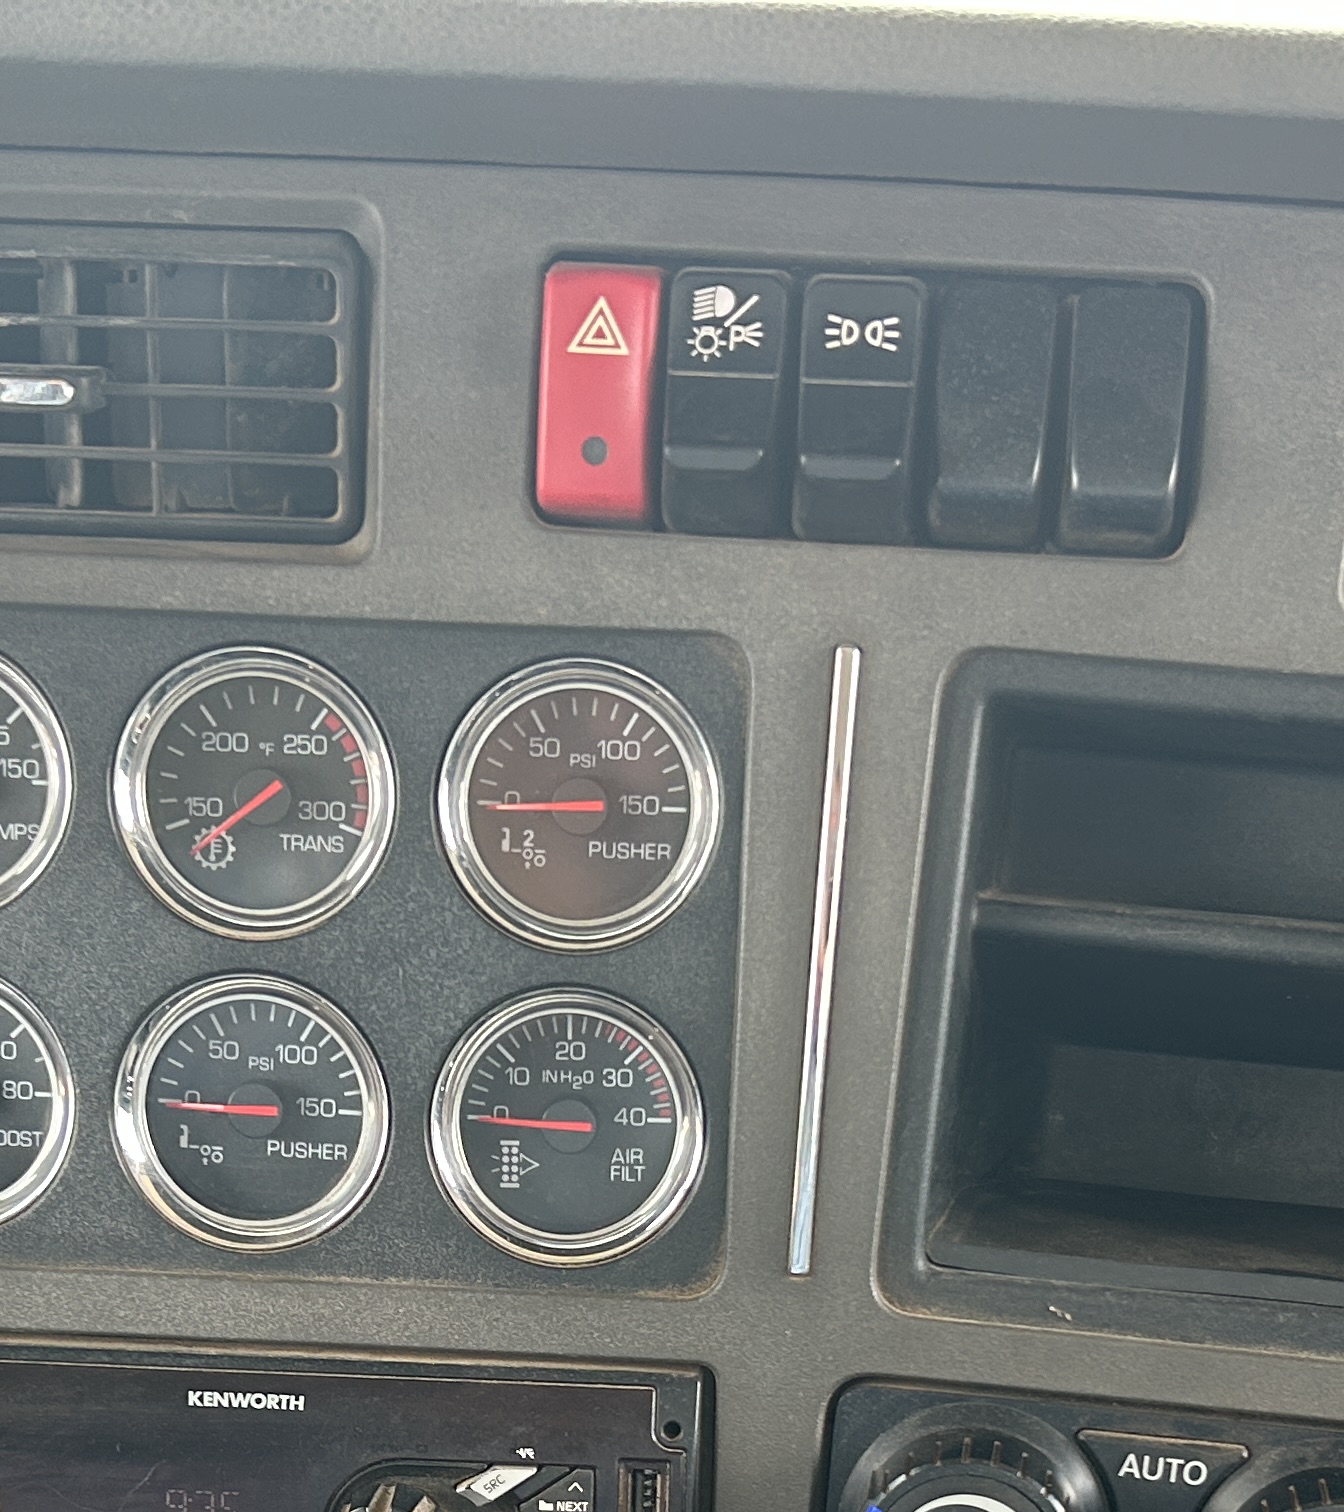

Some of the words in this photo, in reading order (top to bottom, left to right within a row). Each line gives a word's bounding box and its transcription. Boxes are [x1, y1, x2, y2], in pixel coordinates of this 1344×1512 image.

[201, 732, 249, 753] 200
[283, 734, 327, 756] 250
[529, 737, 561, 758] 50
[569, 753, 596, 769] PSI
[597, 740, 641, 761] 100
[184, 796, 223, 818] 150
[298, 801, 346, 822] 300
[619, 795, 660, 816] 150
[279, 833, 345, 854] TRANS
[522, 829, 535, 847] 2
[588, 840, 672, 861] PUSHER
[208, 1040, 239, 1060] 50
[248, 1056, 274, 1071] PSI
[275, 1044, 318, 1065] 100
[555, 1041, 586, 1061] 20
[505, 1067, 530, 1086] 10
[602, 1068, 633, 1088] 30
[2, 1080, 33, 1100] 80
[296, 1097, 336, 1118] 150
[613, 1107, 646, 1126] 40
[267, 1139, 348, 1161] PUSHER
[611, 1148, 644, 1165] AIR
[610, 1165, 646, 1182] FILT
[187, 1390, 306, 1411] KENWORTH
[1117, 1453, 1209, 1487] AUTO
[482, 1473, 507, 1495] SRC
[556, 1501, 589, 1512] NEXT
